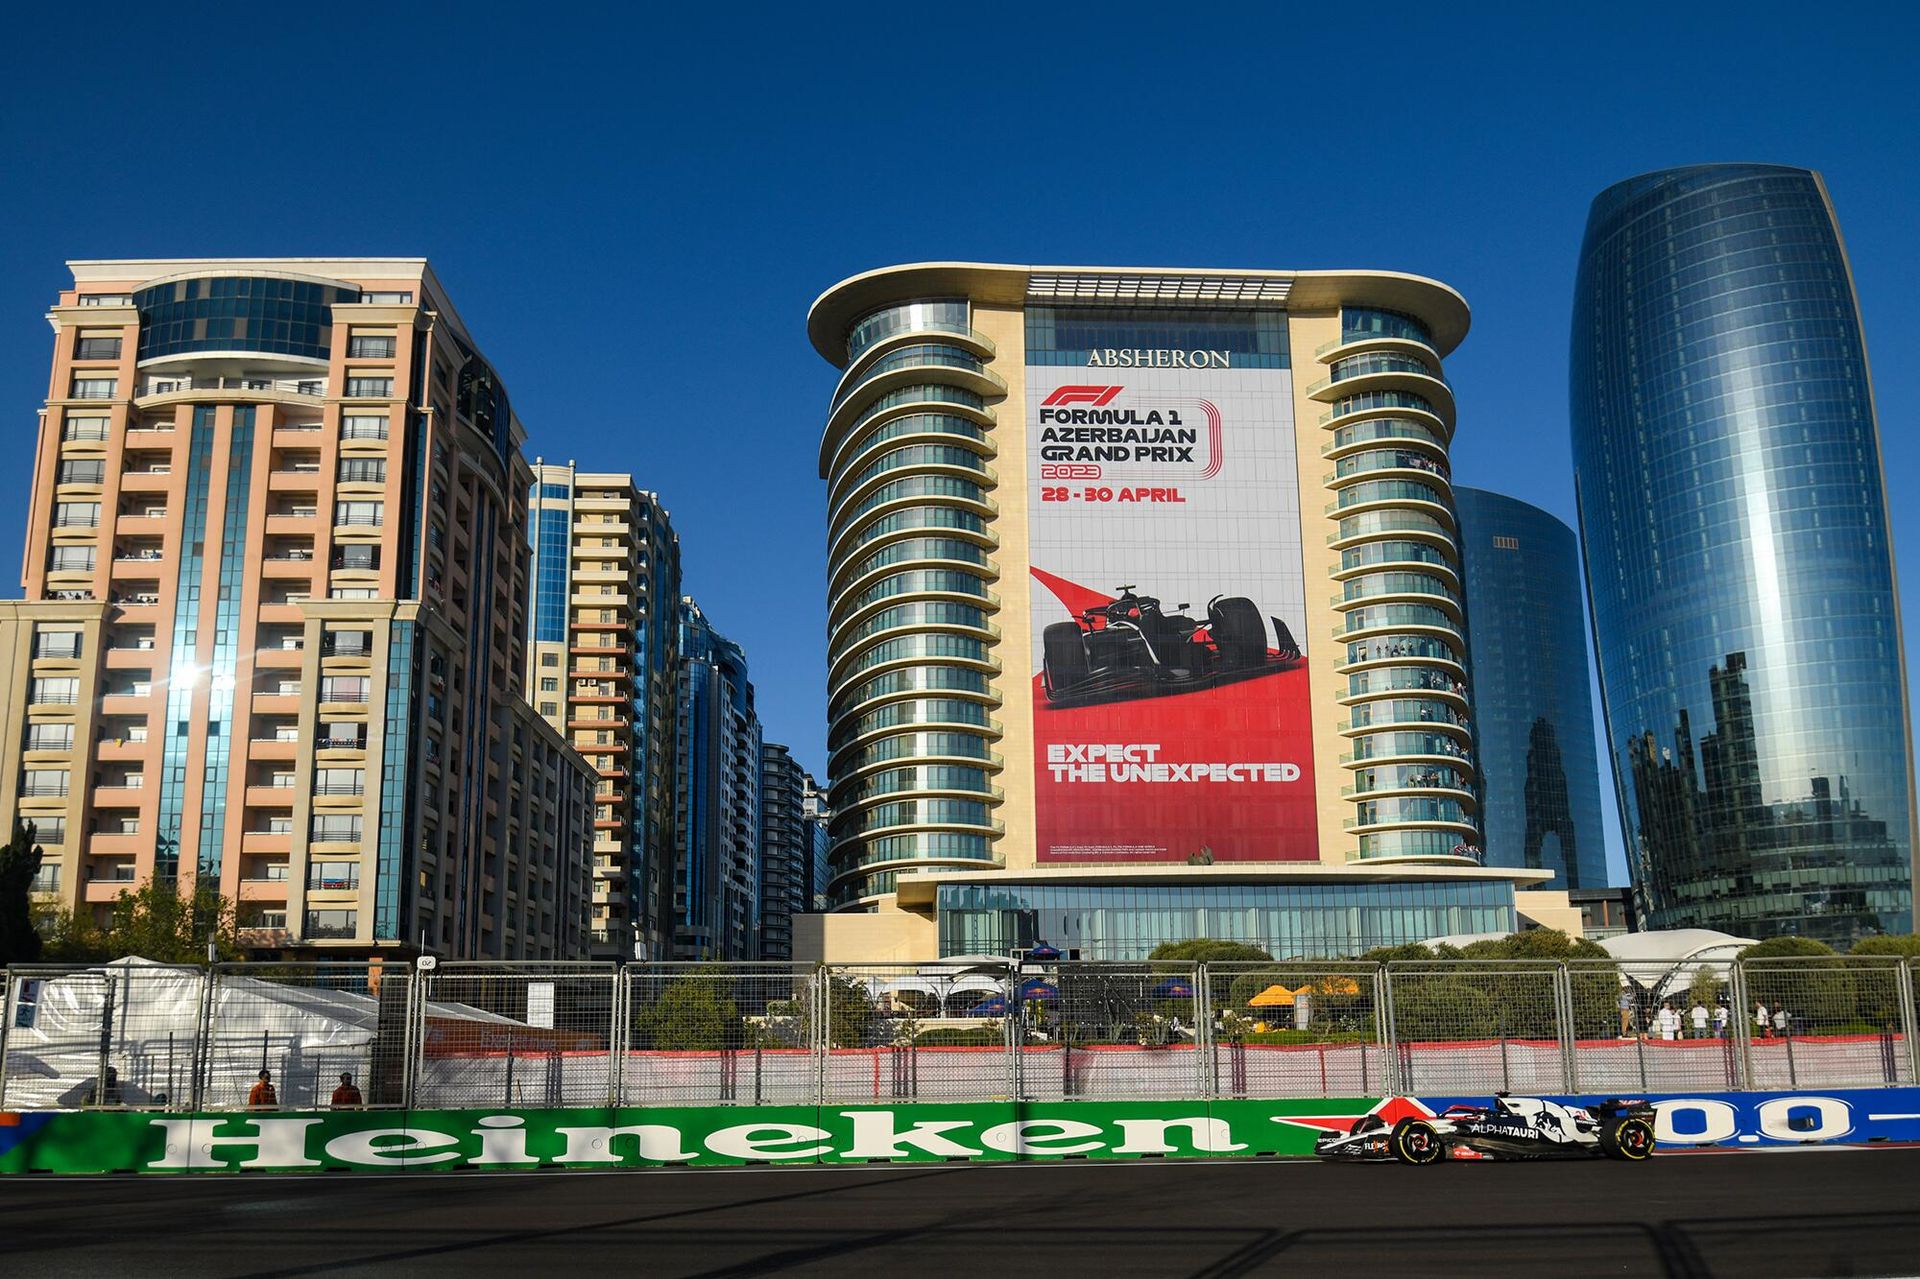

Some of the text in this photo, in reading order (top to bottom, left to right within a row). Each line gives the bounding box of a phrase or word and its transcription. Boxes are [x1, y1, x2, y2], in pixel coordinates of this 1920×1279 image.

[1087, 348, 1231, 368] ABSHERON
[1041, 385, 1124, 406] F1
[1040, 409, 1182, 425] FORMULA 1
[1040, 428, 1196, 443] AZERBAIJAN
[1040, 446, 1194, 463] GRAND PRIX
[1041, 464, 1101, 480] 2023
[1118, 487, 1186, 502] APRIL
[1047, 744, 1160, 762] EXPECT
[1048, 763, 1301, 782] THE UNEXPECTED
[148, 1111, 1248, 1168] Heineken
[1471, 1123, 1539, 1139] ALPHATAURI
